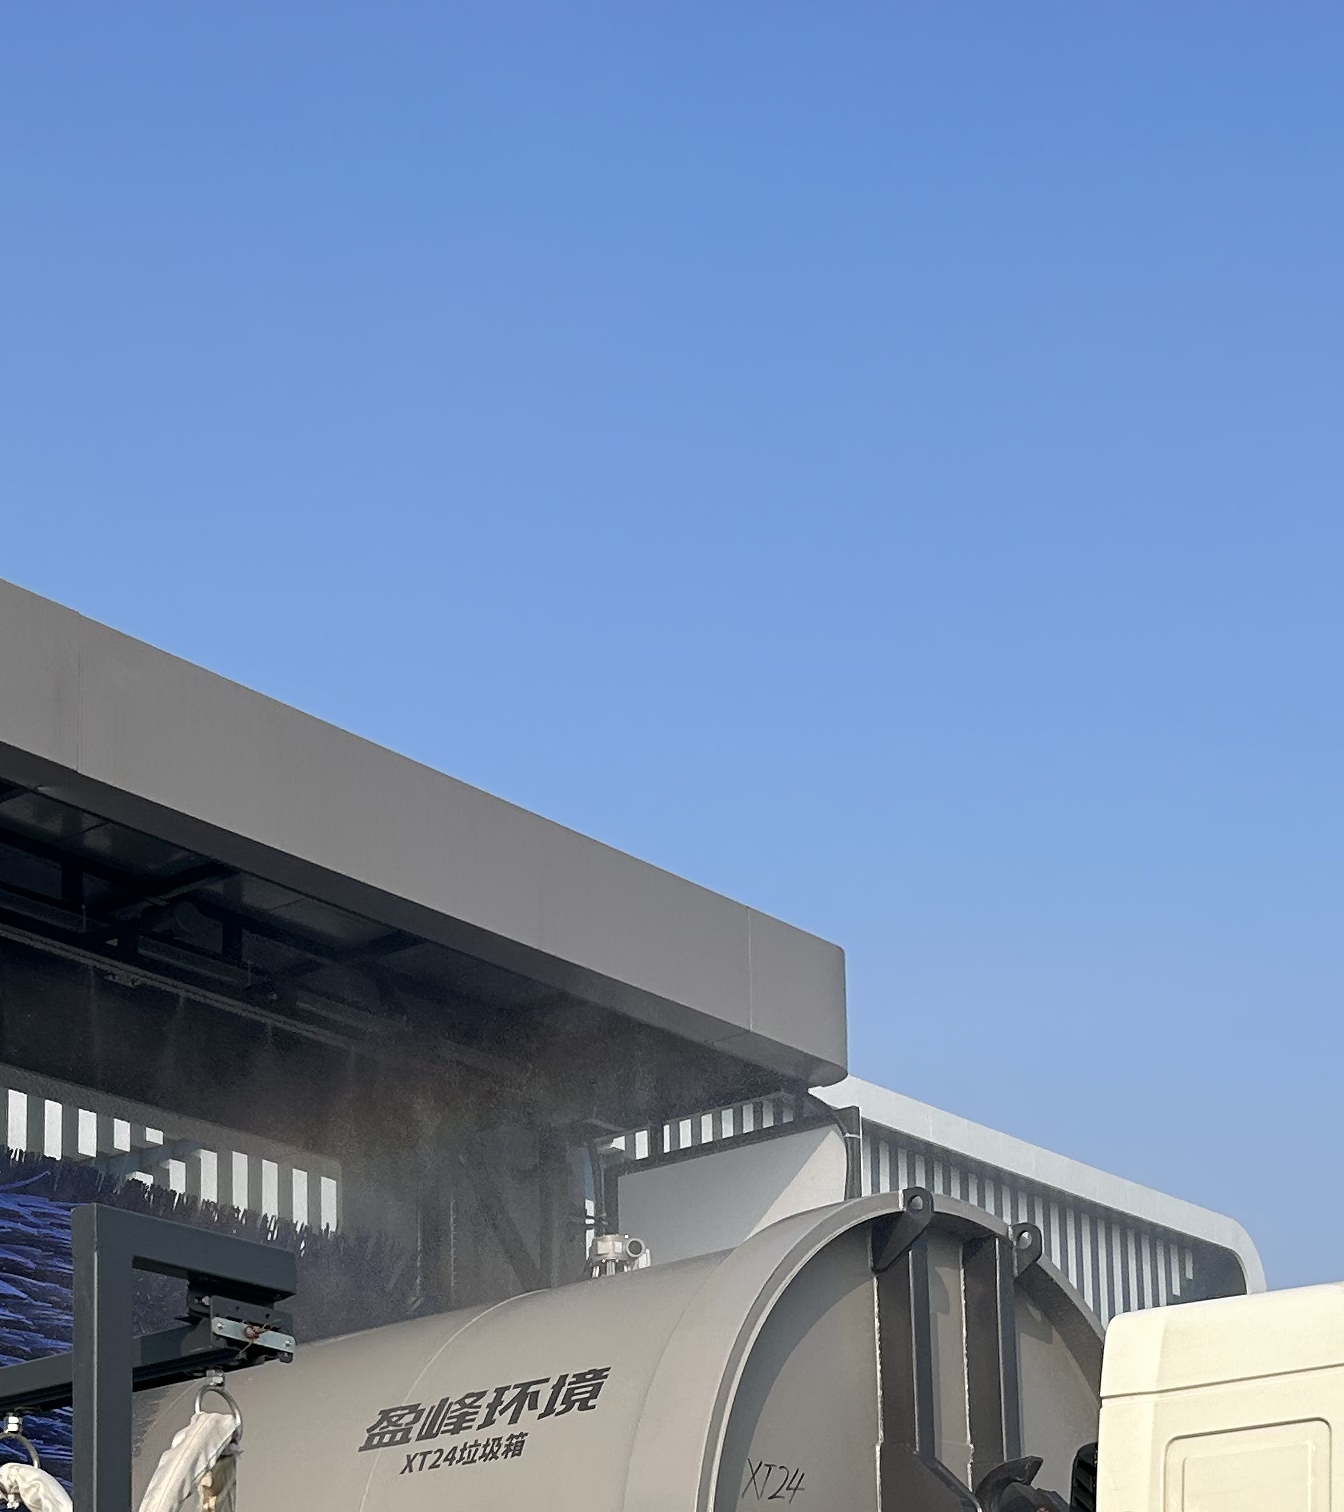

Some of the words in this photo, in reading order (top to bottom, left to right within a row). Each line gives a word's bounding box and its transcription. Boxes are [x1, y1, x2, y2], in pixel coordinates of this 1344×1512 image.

[358, 1366, 612, 1453] 盈峰环境
[399, 1431, 529, 1475] XT24垃圾箱
[741, 1457, 805, 1505] XT24
